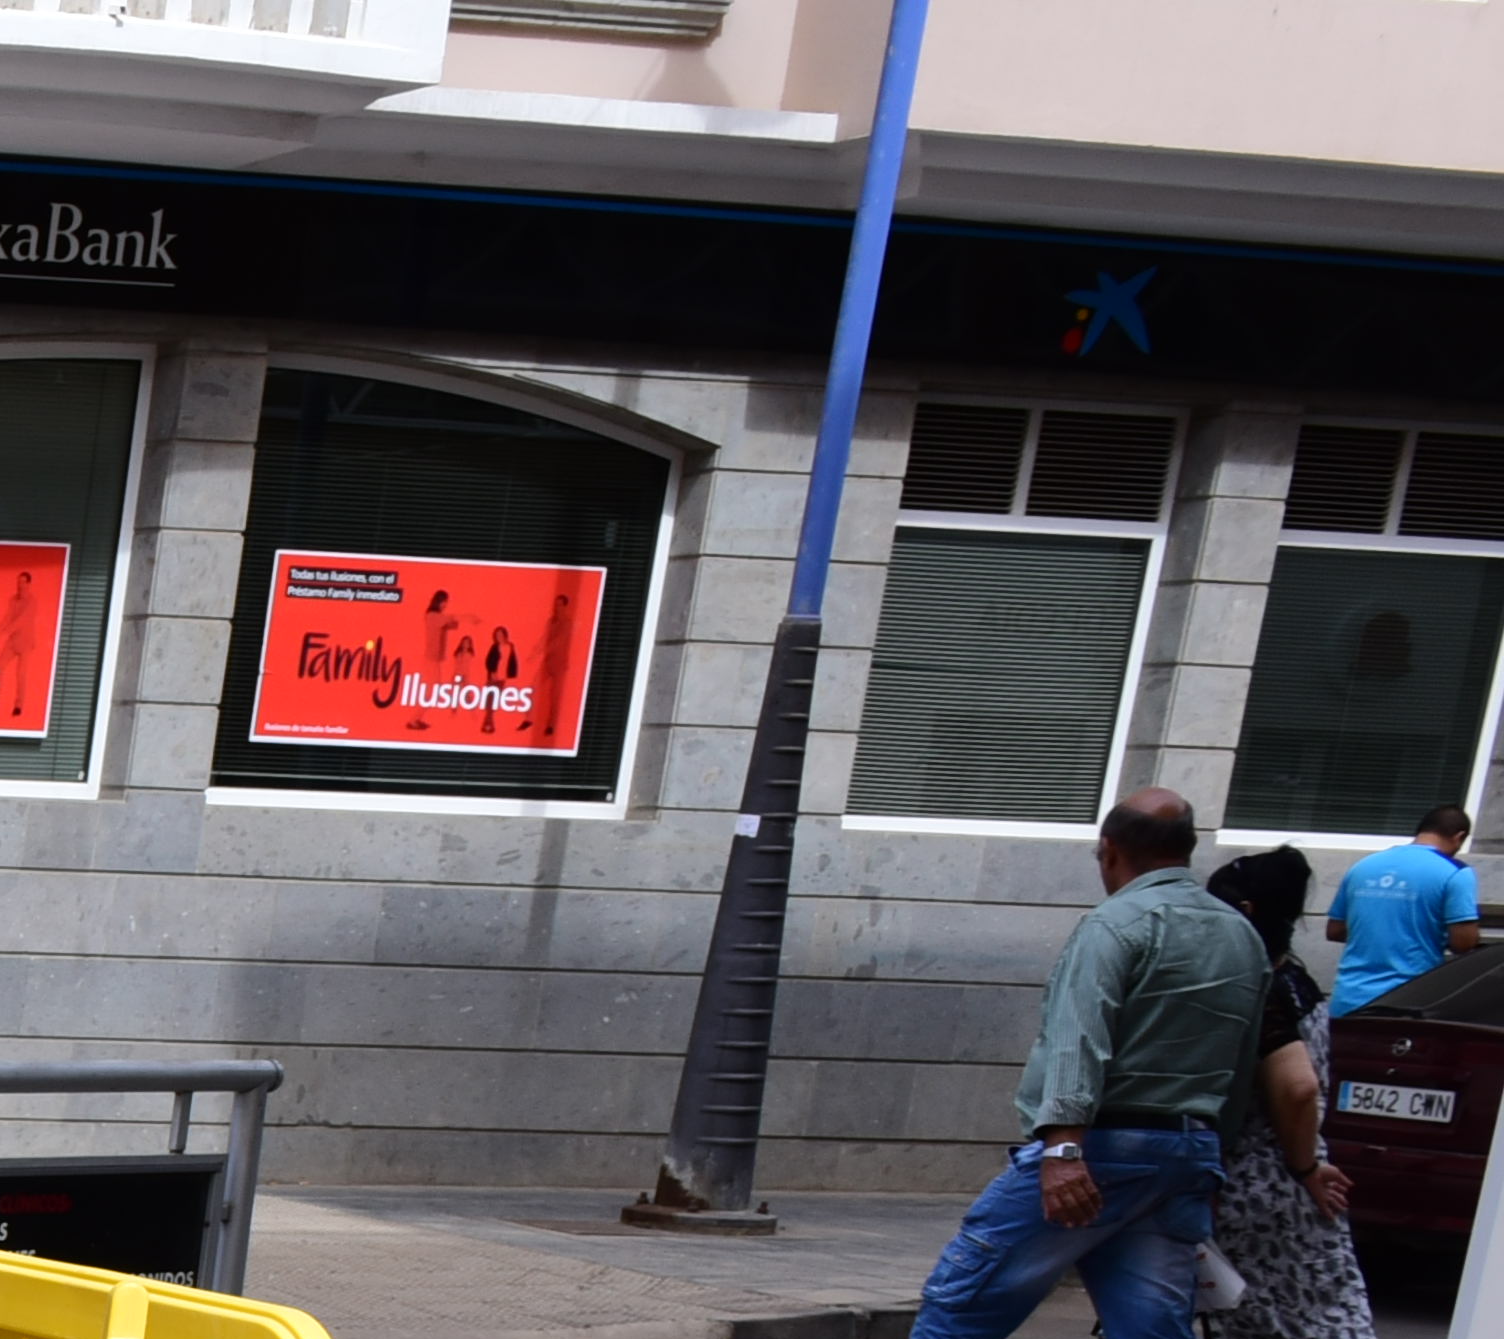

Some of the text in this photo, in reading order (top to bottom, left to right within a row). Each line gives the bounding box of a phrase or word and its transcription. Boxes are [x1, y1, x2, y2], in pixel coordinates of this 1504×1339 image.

[297, 632, 402, 709] Family
[400, 672, 533, 712] Ilusiones
[1352, 1085, 1399, 1114] 5842
